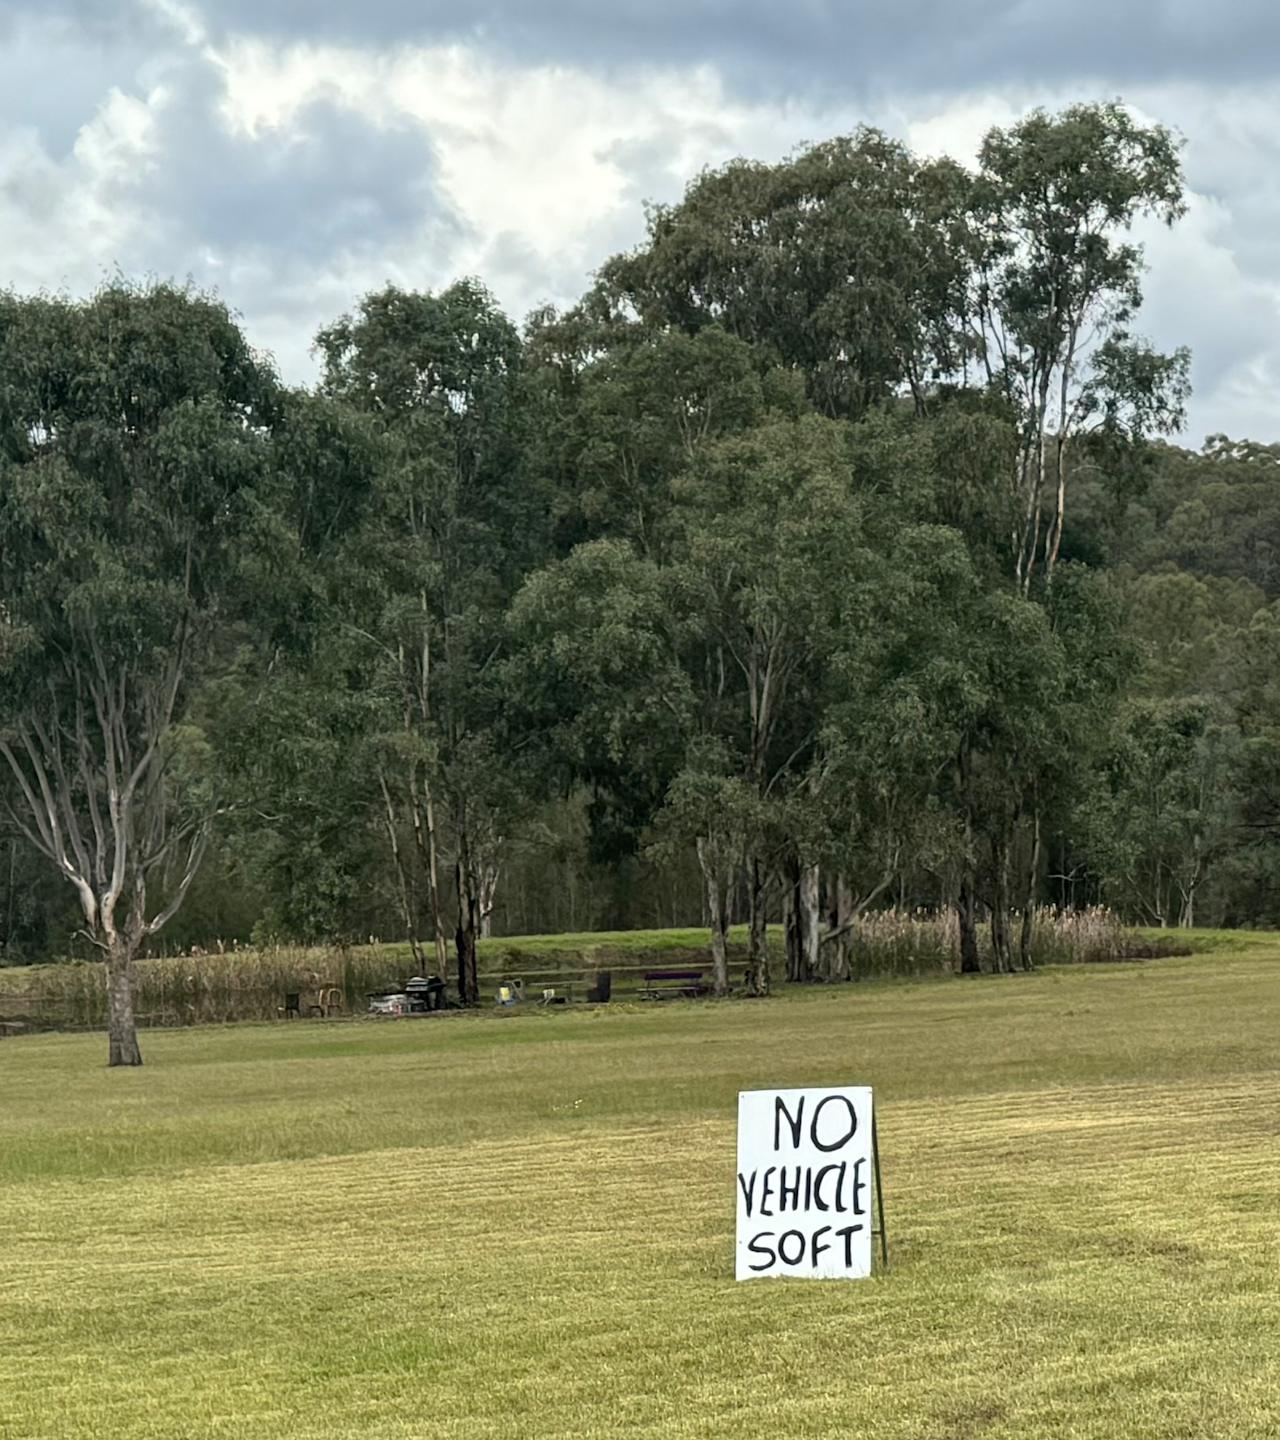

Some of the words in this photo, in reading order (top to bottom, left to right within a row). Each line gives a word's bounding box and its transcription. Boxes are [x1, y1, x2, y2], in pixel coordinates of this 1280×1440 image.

[774, 1095, 858, 1153] NO
[738, 1157, 867, 1218] VEHICLE
[748, 1224, 863, 1272] SOFT
